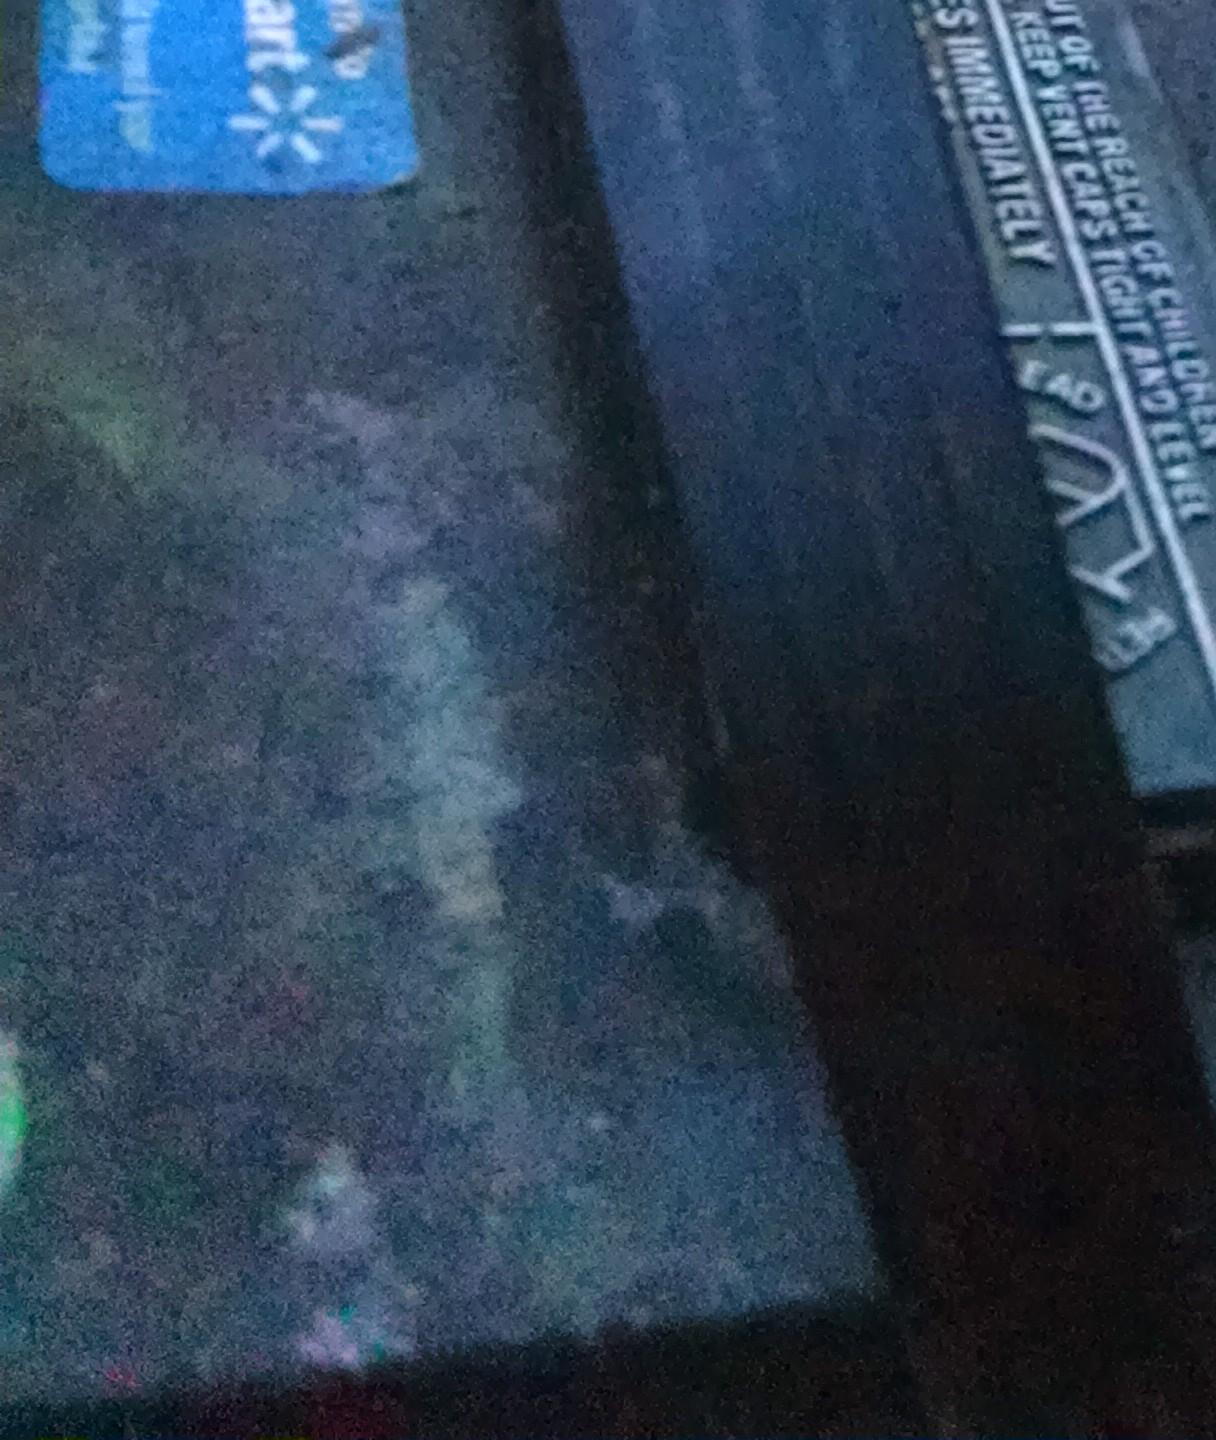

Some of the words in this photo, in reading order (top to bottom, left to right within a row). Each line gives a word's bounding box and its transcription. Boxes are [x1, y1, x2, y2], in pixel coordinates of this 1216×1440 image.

[1007, 10, 1064, 78] KEEP
[1054, 35, 1101, 72] OF
[1032, 84, 1090, 155] VENT
[1071, 80, 1121, 130] THE
[941, 34, 1058, 272] IMMEDIATELY
[1090, 137, 1157, 233] REACH
[1059, 162, 1120, 243] CAPS
[1087, 247, 1152, 339] TIGHT
[1126, 239, 1175, 282] OF
[1120, 341, 1180, 420] AND
[1148, 418, 1214, 525] LEVEL
